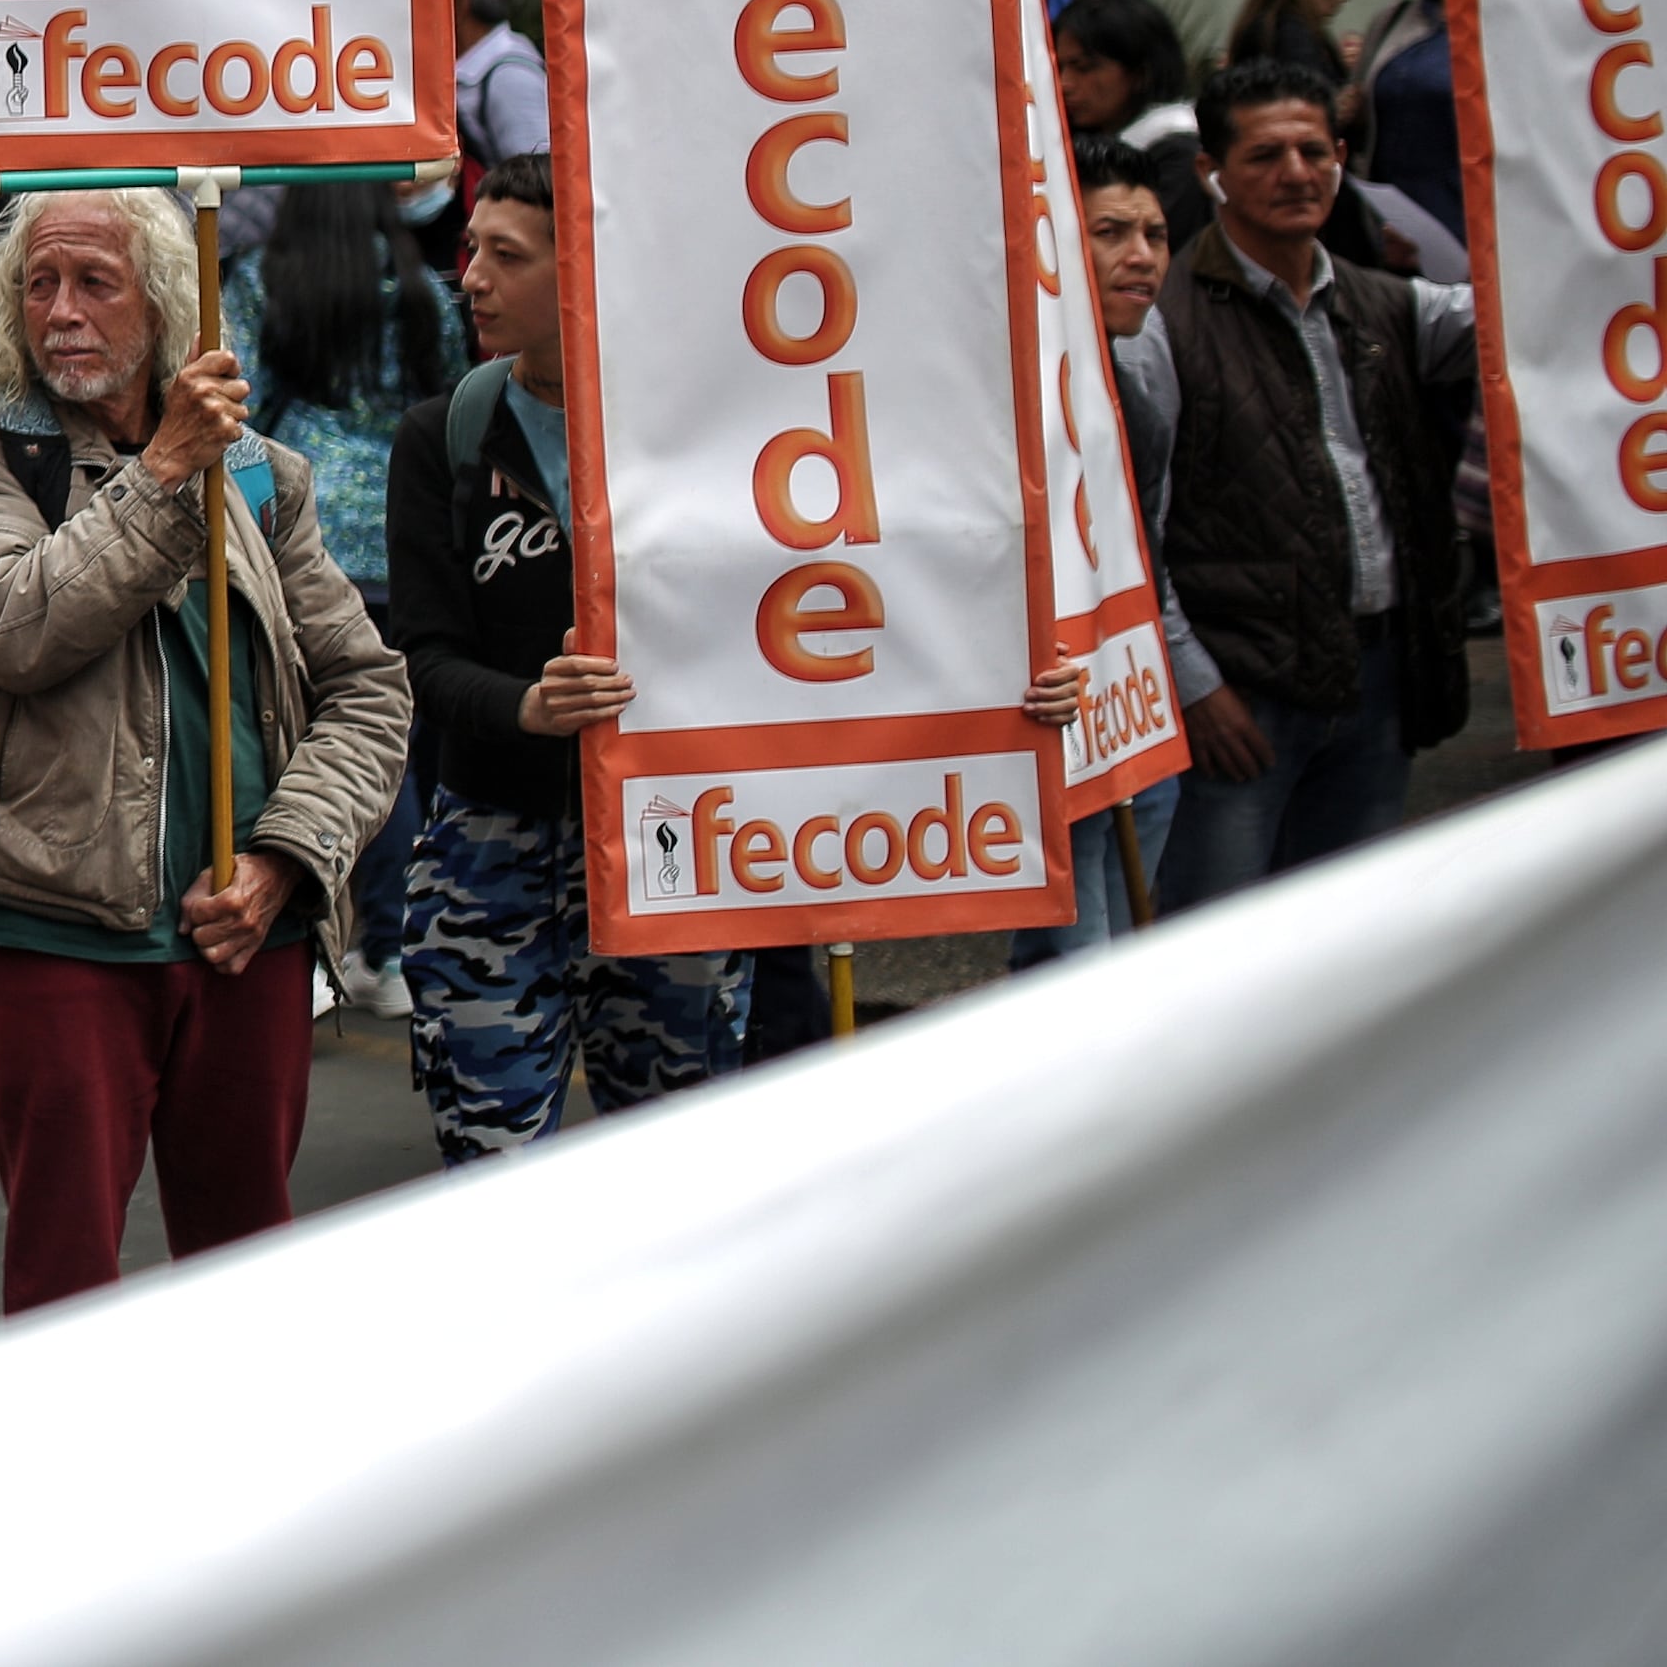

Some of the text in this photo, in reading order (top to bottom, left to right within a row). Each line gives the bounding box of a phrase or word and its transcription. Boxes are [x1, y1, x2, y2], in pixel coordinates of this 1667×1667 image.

[42, 5, 395, 119] fecode
[1583, 604, 1667, 696] fe
[691, 772, 1023, 896] fecode
